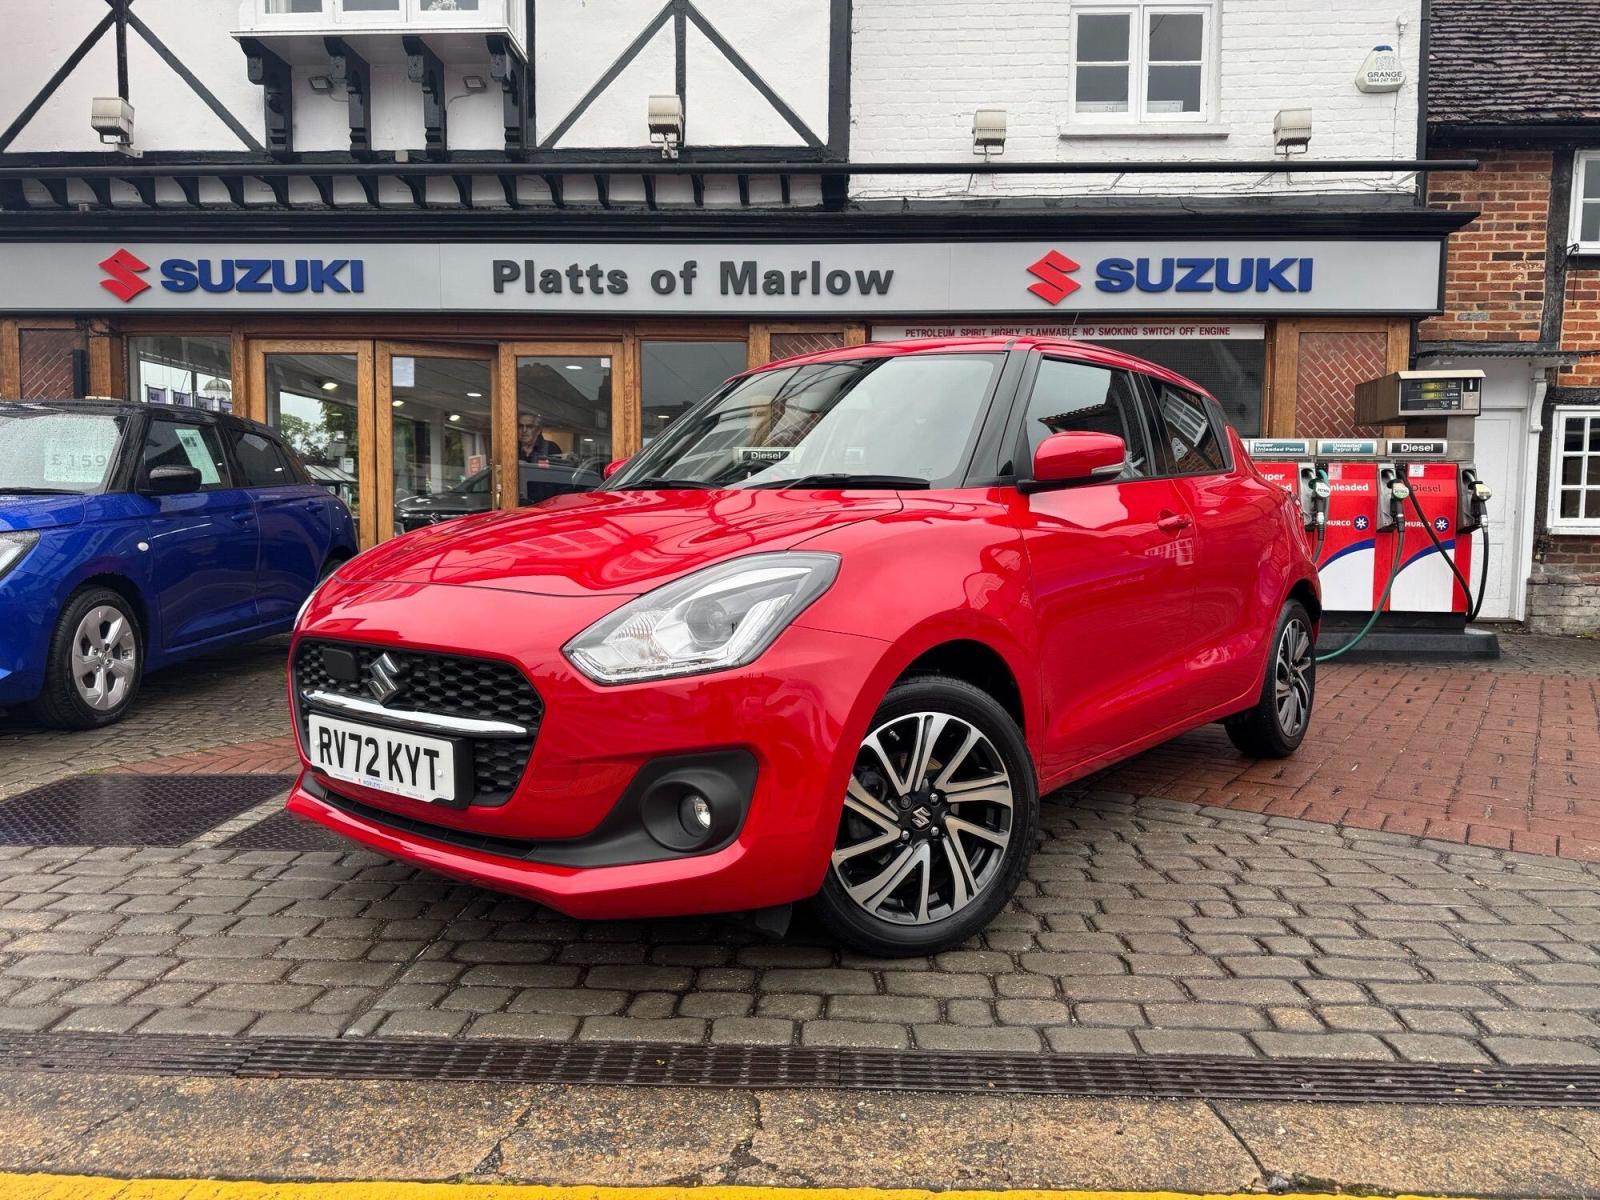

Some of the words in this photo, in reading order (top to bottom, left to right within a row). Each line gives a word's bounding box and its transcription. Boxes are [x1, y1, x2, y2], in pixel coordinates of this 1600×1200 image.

[160, 258, 364, 293] SUZUKI
[492, 259, 629, 295] Platts
[650, 260, 697, 295] of
[719, 260, 894, 295] Marlow
[1095, 257, 1313, 293] SUZUKI
[905, 328, 956, 338] PETROLEUM
[960, 328, 987, 337] SPIRIT
[991, 328, 1020, 337] HIGHLY
[1025, 327, 1077, 337] FLAMMABLE
[1082, 327, 1095, 336] NO
[1098, 327, 1138, 336] SMOKING
[1142, 327, 1175, 336] SWITCH
[1179, 327, 1195, 336] OFF
[1199, 327, 1231, 336] ENGINE
[1400, 443, 1434, 452] Diesel
[750, 451, 781, 460] Diesel
[1262, 473, 1286, 481] uper
[1329, 482, 1369, 492] nleaded
[1411, 484, 1441, 492] Diesel
[319, 725, 381, 778] RV72
[387, 740, 440, 791] KYT
